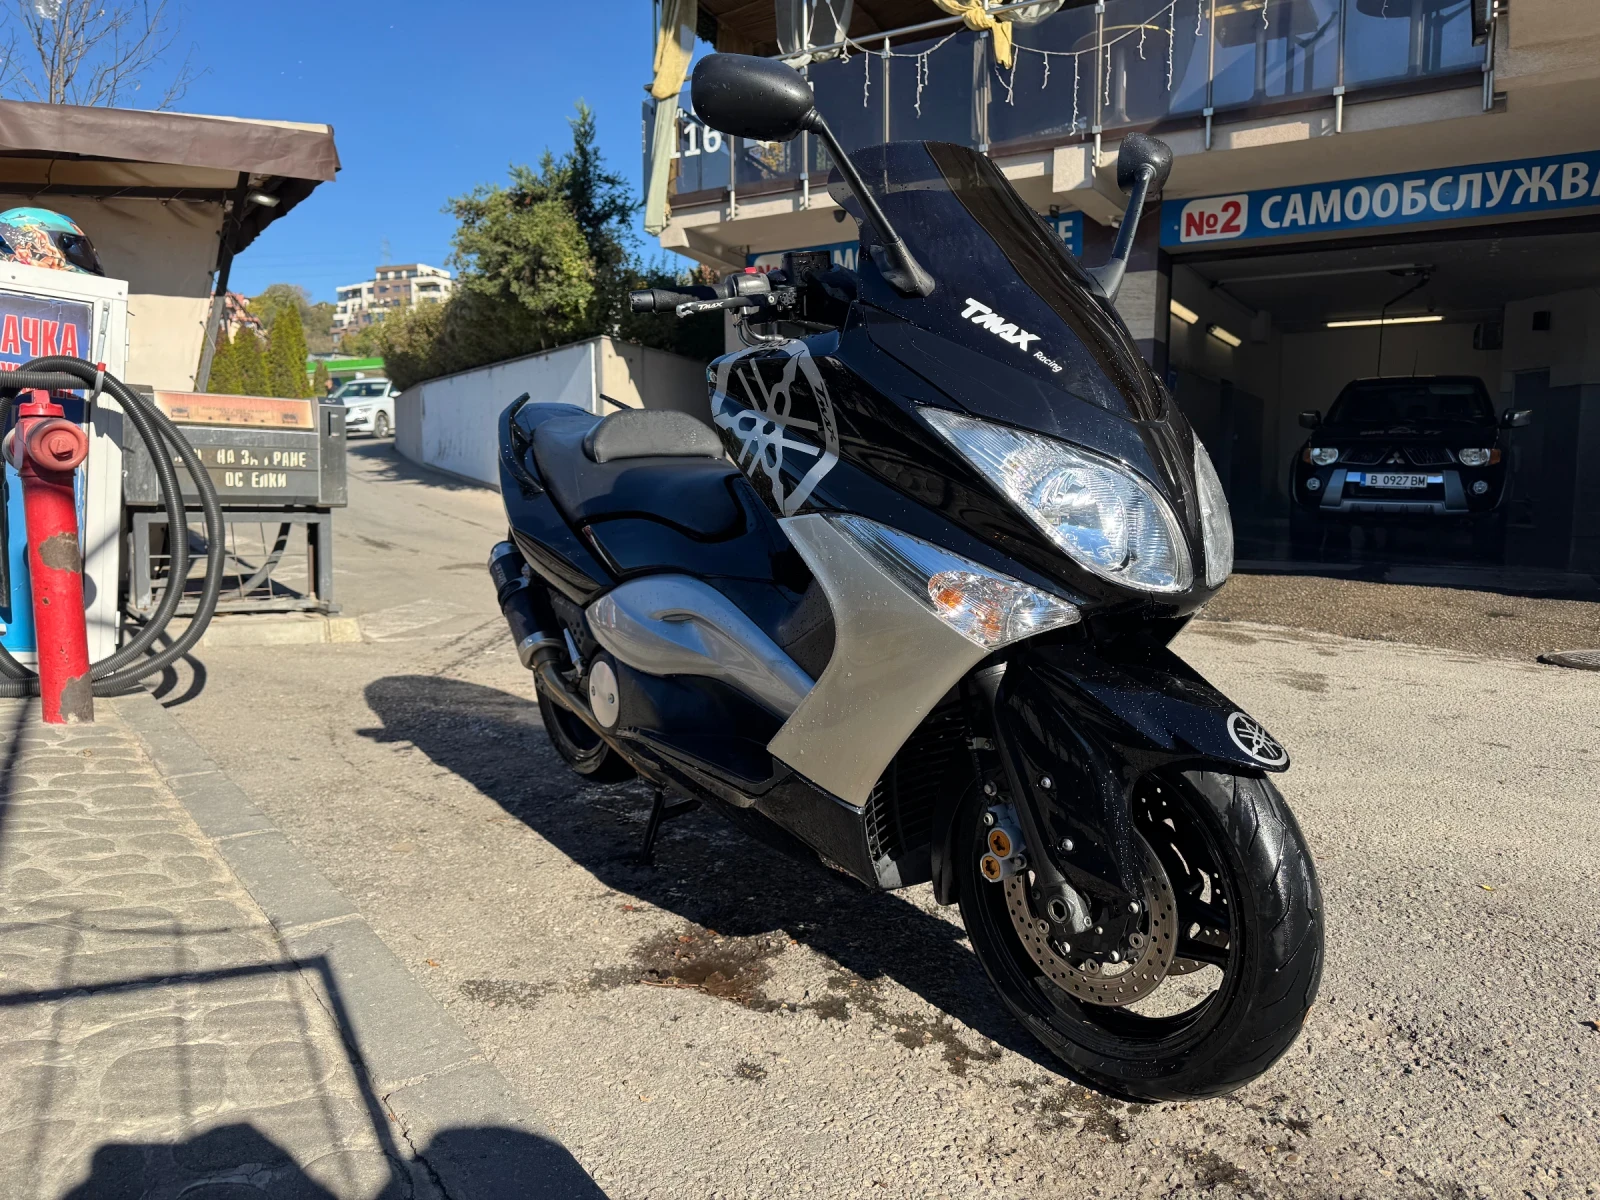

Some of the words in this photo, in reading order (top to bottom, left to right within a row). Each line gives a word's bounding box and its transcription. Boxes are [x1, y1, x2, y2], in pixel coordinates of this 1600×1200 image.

[697, 301, 724, 311] TMAX
[961, 297, 1042, 352] TMAX
[1033, 350, 1063, 373] Racing
[1383, 475, 1409, 486] 0927
